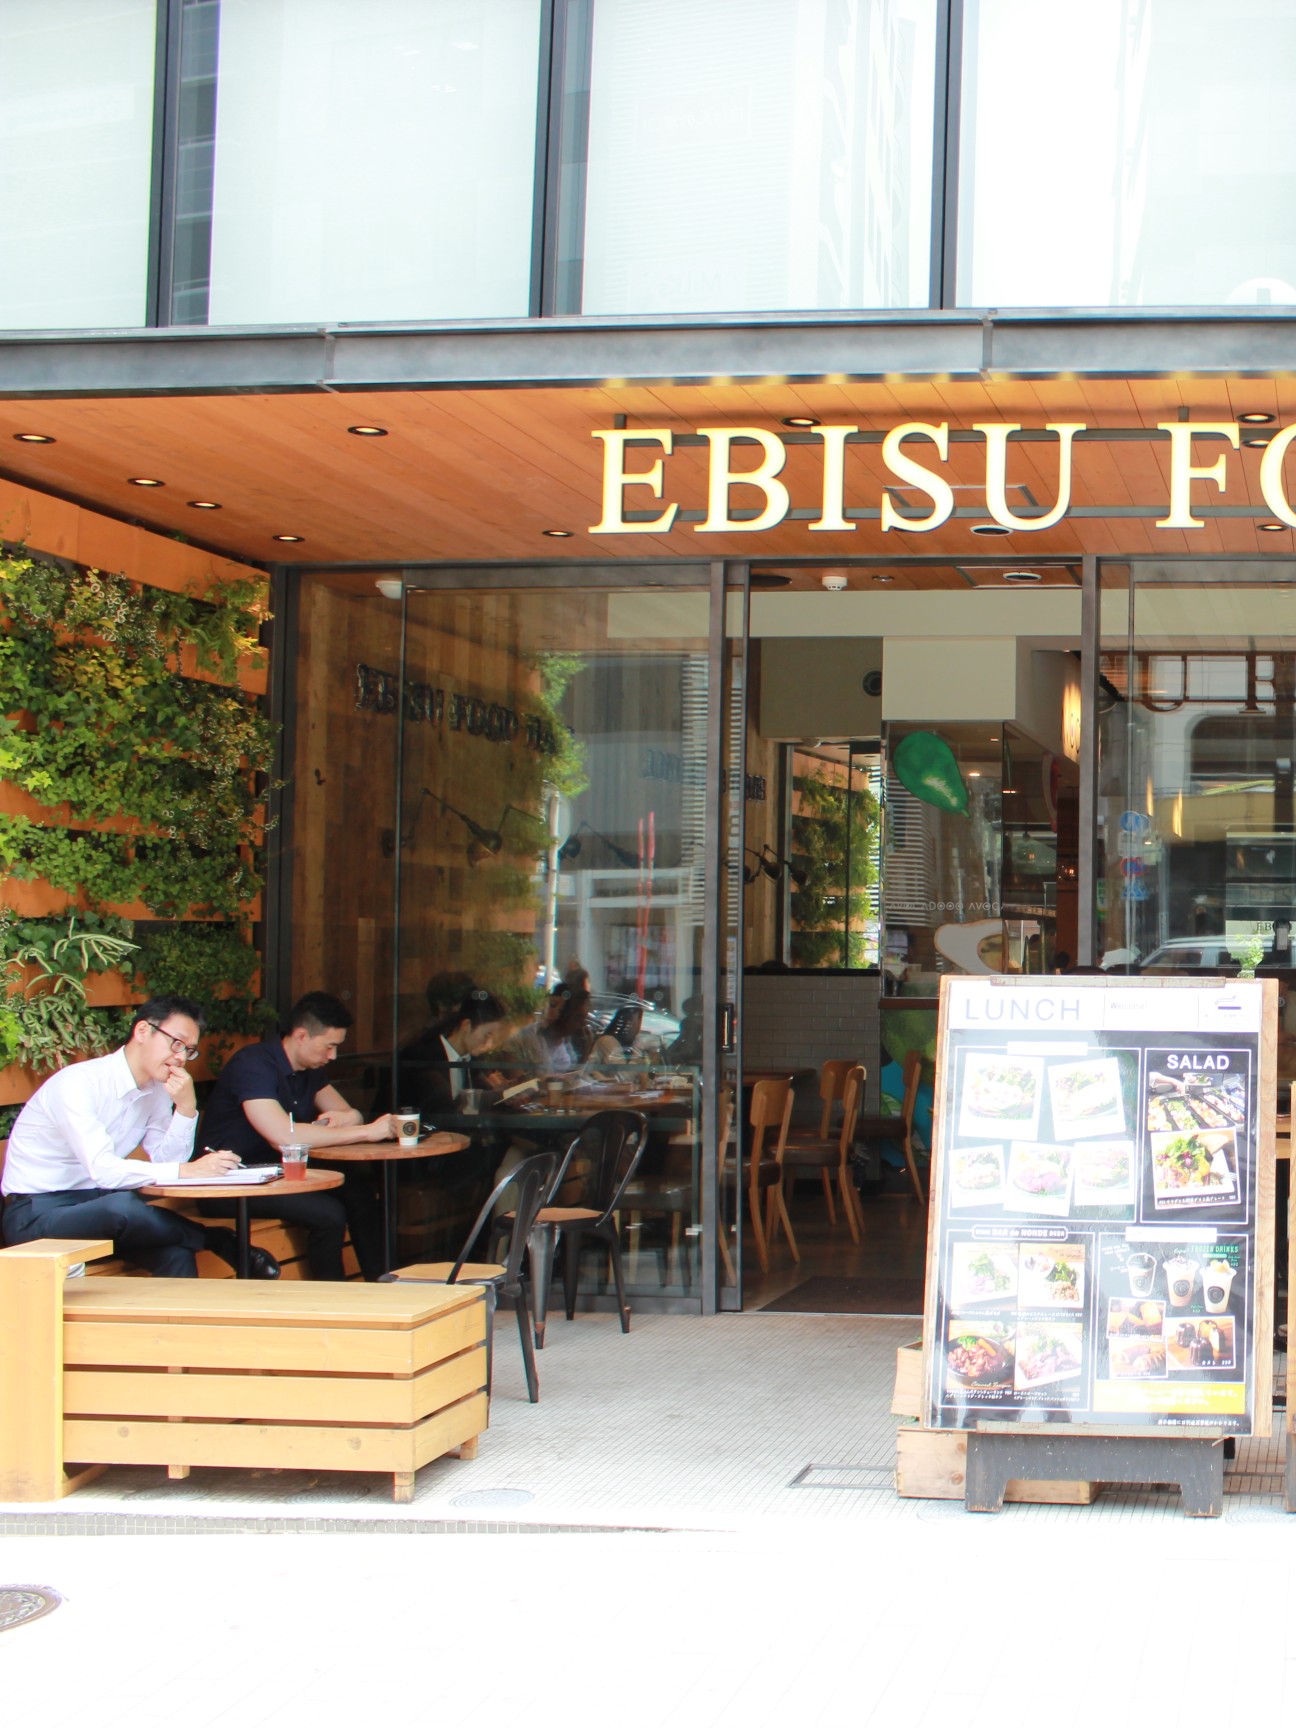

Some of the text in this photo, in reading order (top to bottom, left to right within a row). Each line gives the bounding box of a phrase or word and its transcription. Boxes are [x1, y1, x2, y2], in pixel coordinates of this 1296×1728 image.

[588, 421, 1087, 534] EBISU
[965, 998, 1081, 1021] LUNCH
[1167, 1053, 1230, 1071] SALAD
[991, 1229, 1009, 1237] BAR
[1215, 1245, 1239, 1253] DRINKS
